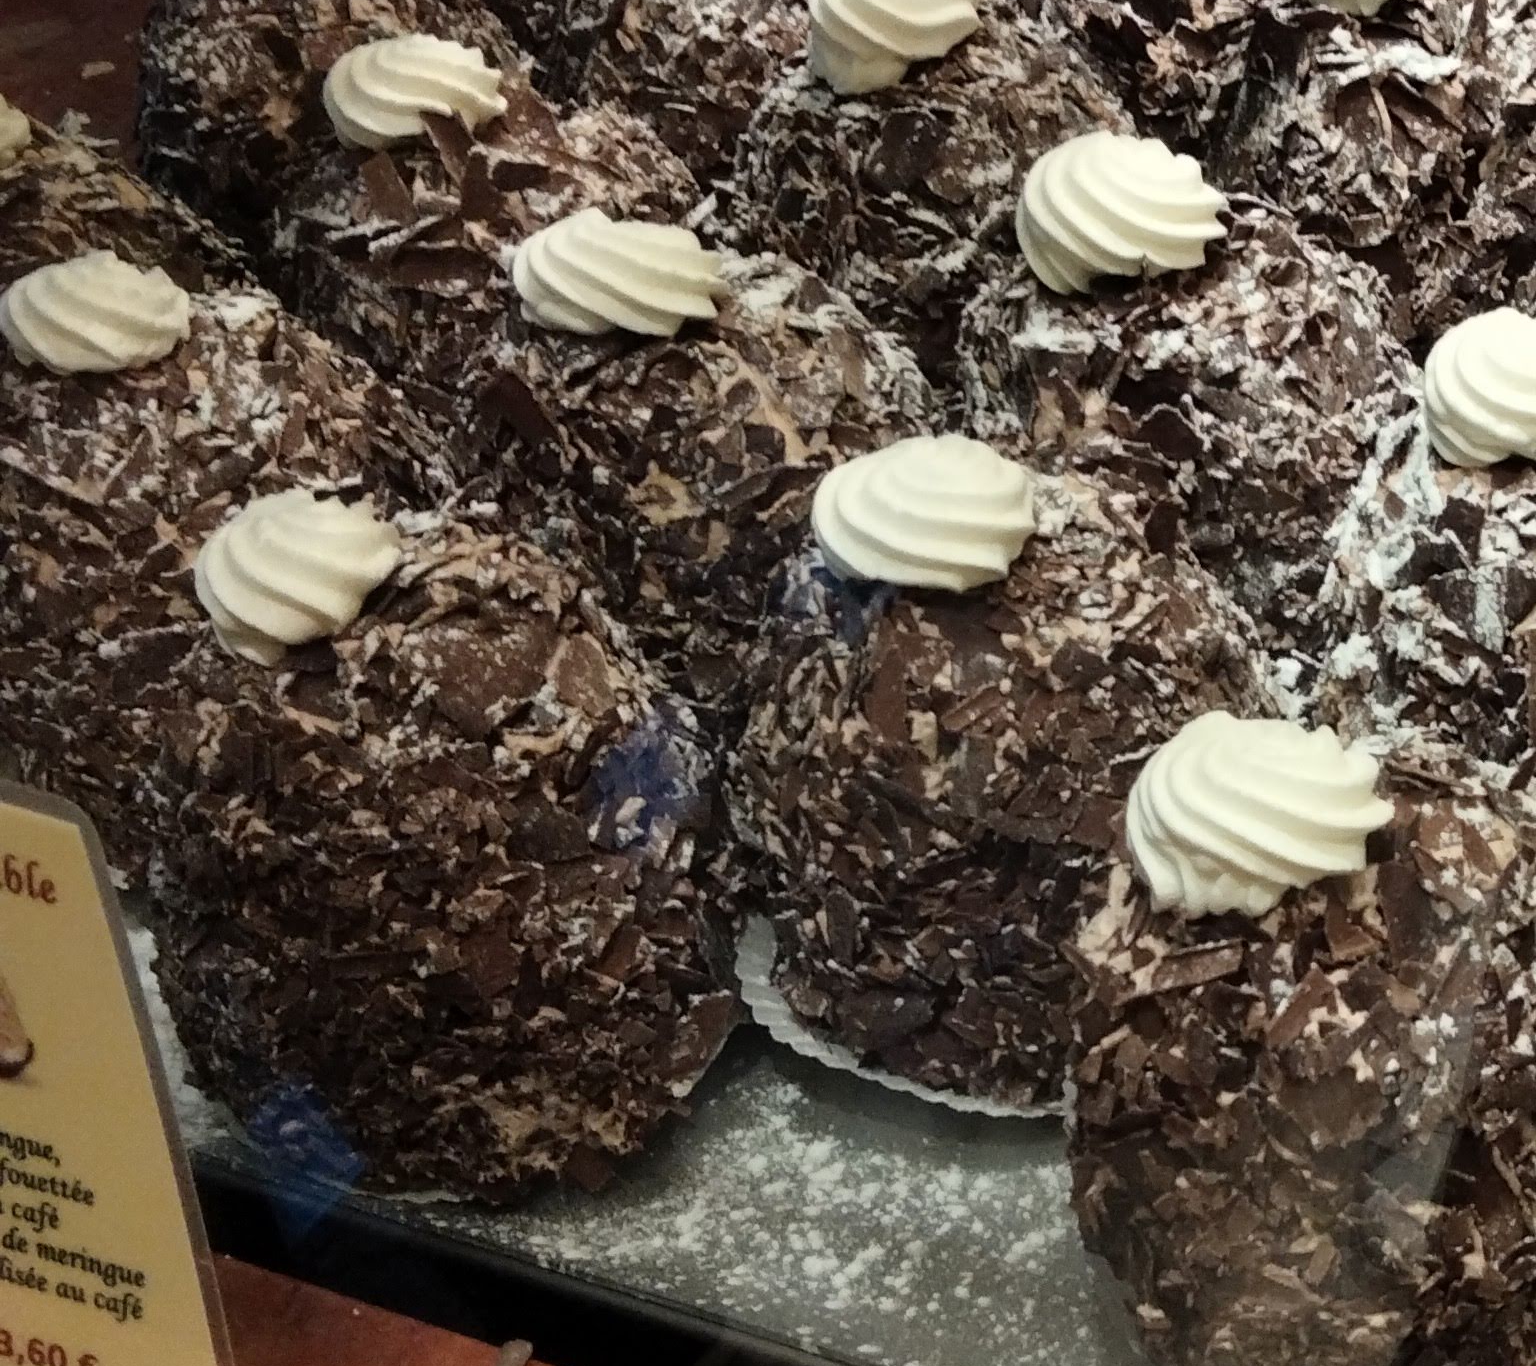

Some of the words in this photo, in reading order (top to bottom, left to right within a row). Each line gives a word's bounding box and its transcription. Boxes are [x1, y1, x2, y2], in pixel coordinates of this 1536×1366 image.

[0, 853, 58, 905] ble
[0, 1157, 95, 1208] fouettée
[11, 1201, 60, 1233] café
[2, 1226, 28, 1253] de
[36, 1244, 146, 1288] meringue
[55, 1281, 86, 1304] au
[93, 1292, 144, 1323] café
